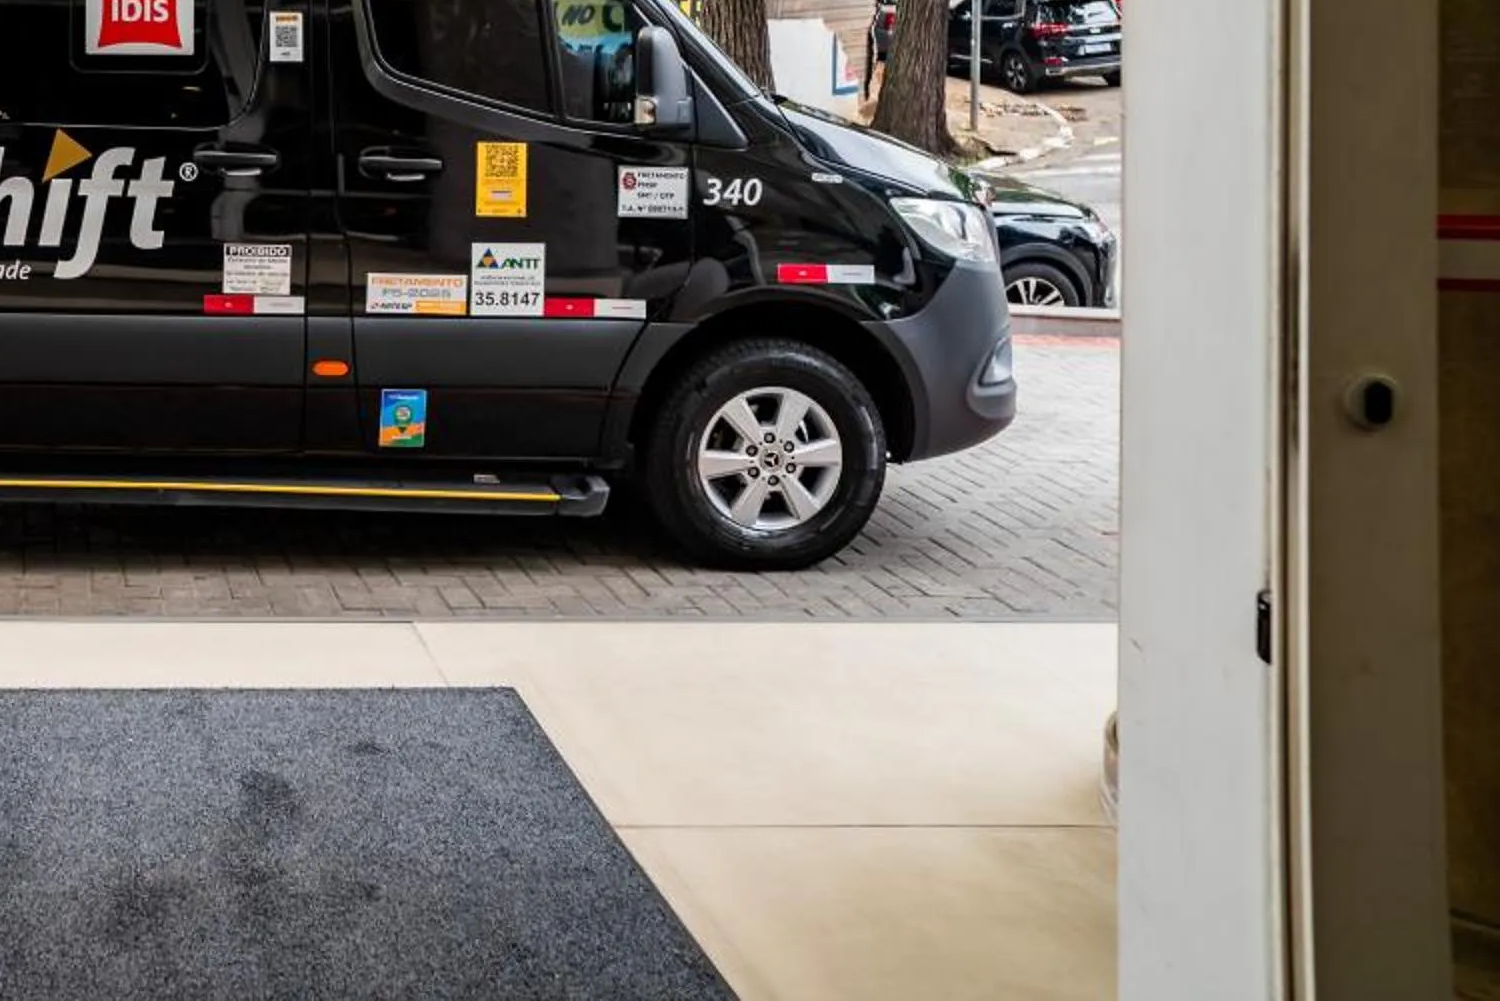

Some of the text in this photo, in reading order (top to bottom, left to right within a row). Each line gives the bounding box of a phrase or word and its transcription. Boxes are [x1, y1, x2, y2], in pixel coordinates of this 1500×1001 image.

[703, 177, 763, 206] 340
[500, 257, 541, 269] ANTT
[474, 292, 541, 306] 35.8147
